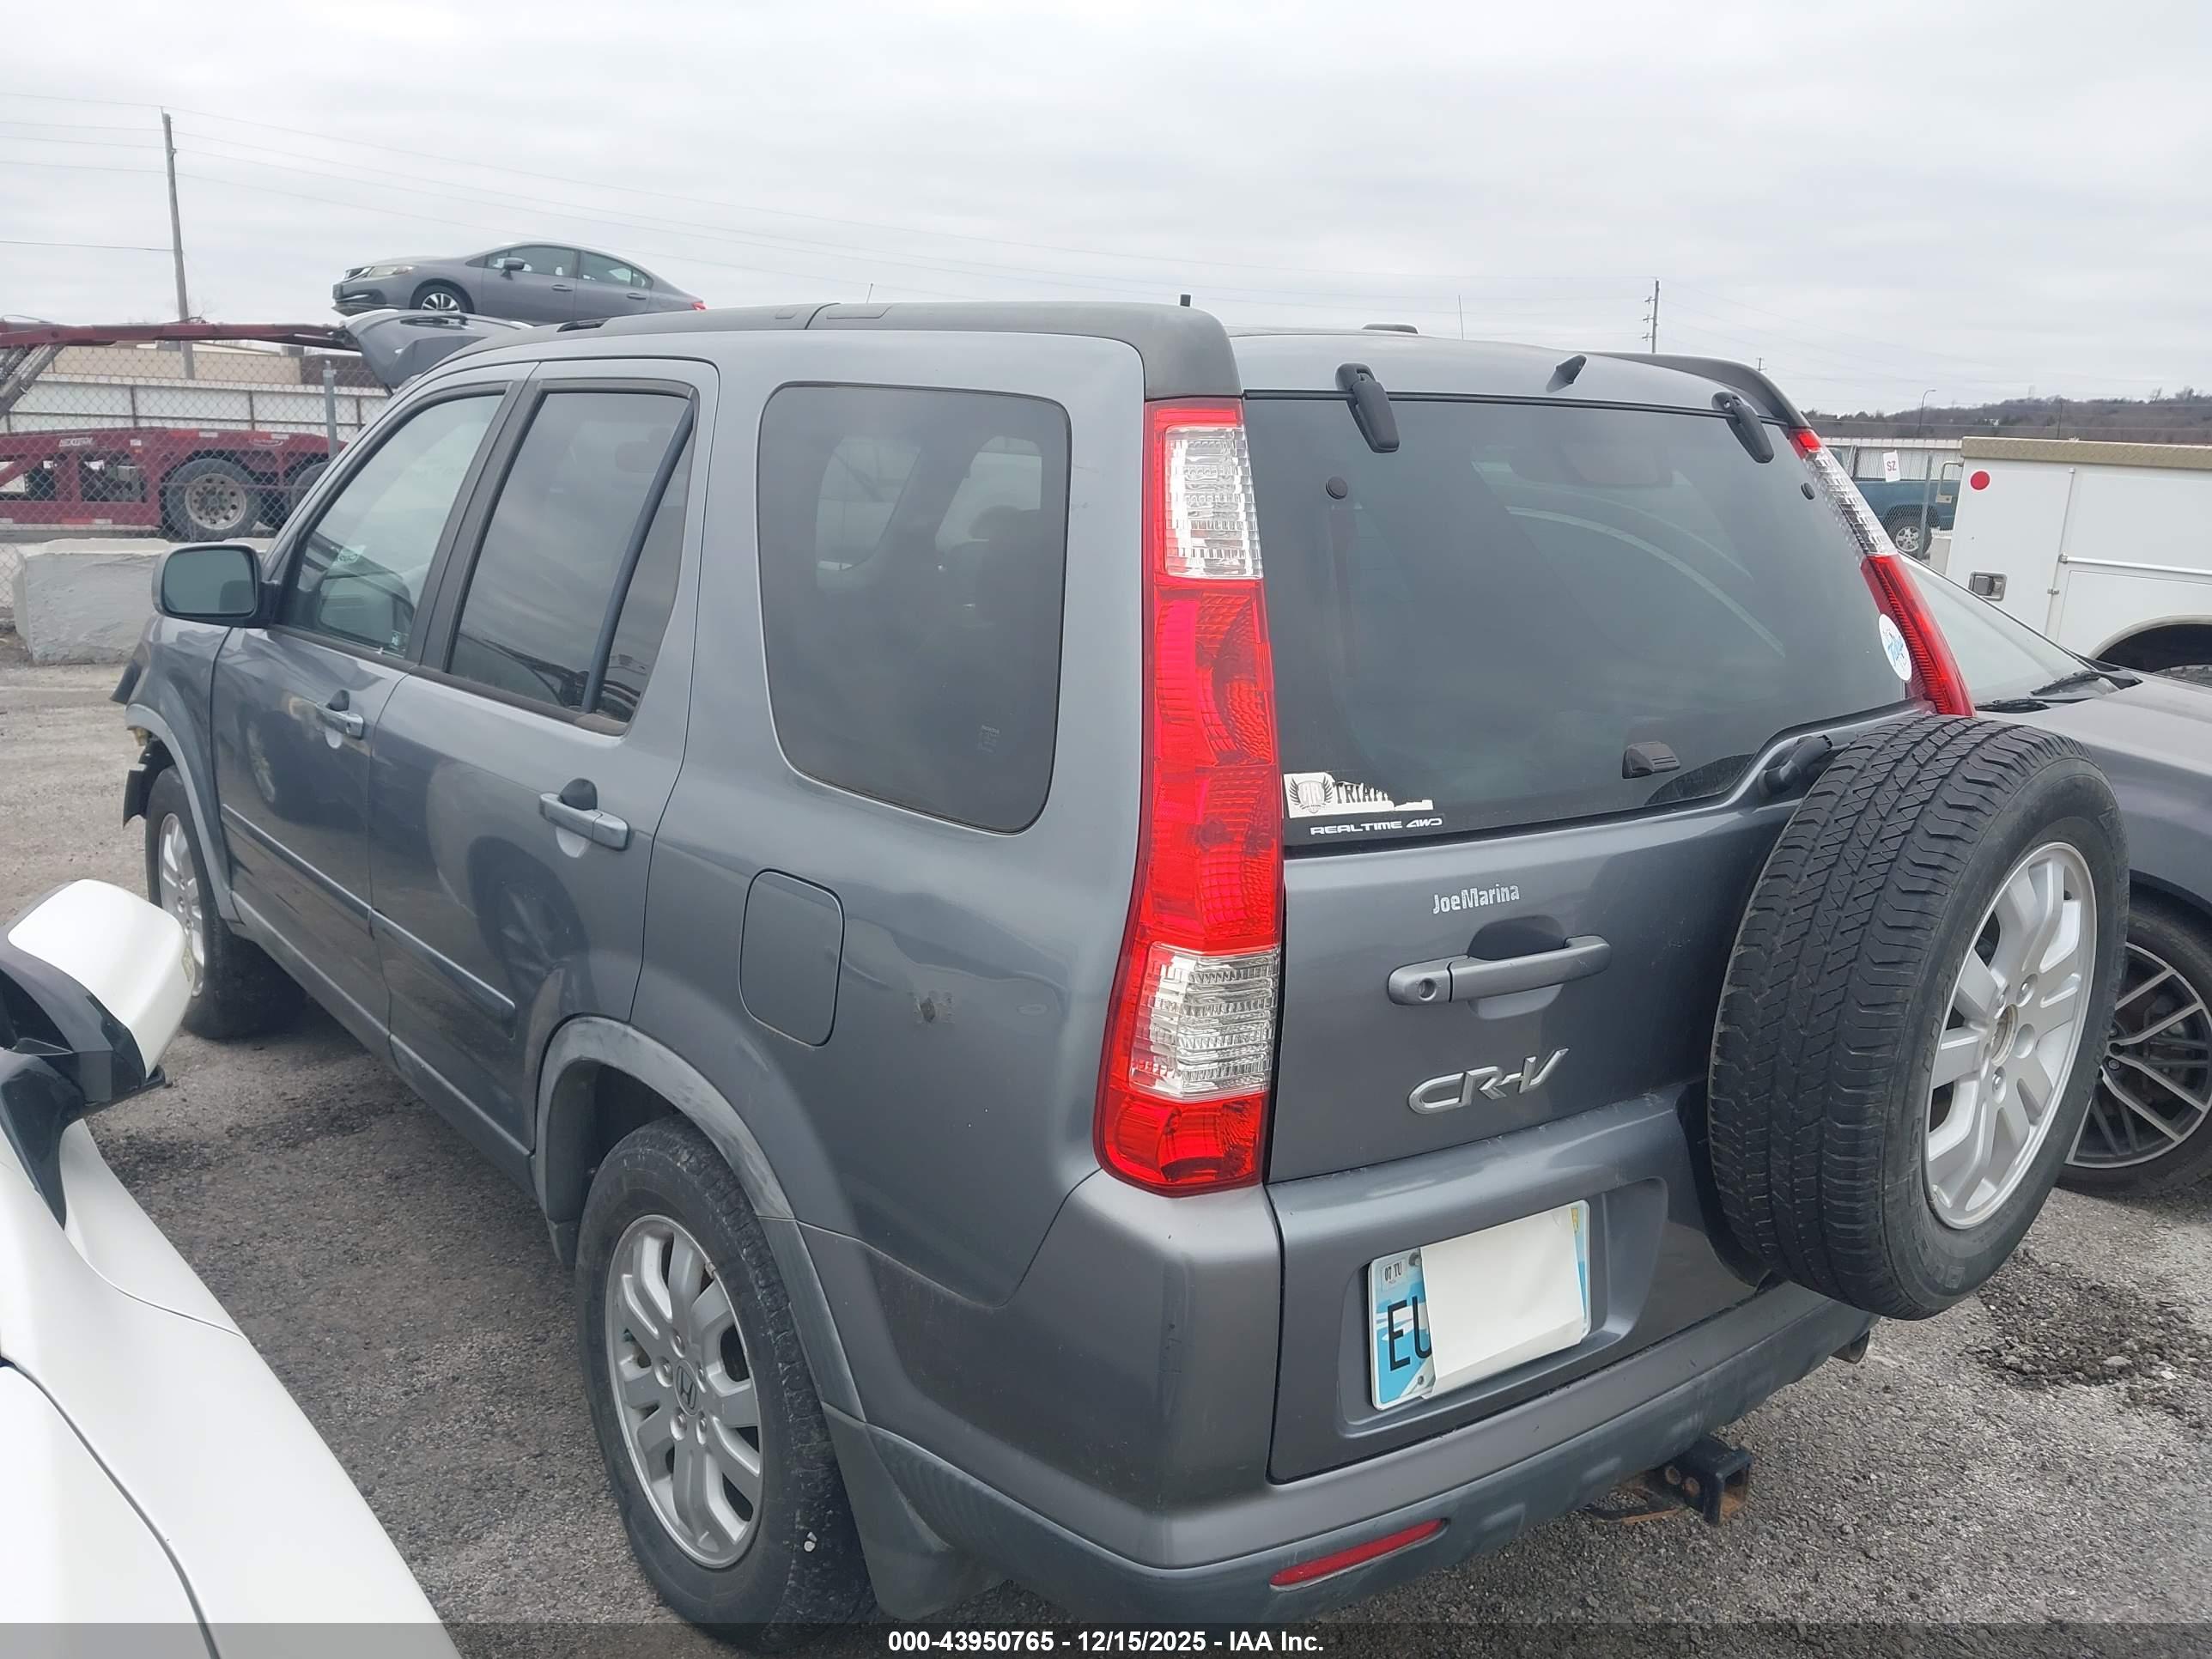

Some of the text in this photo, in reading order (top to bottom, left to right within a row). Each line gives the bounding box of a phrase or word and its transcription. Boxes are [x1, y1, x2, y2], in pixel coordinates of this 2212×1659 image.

[1310, 817, 1443, 836] REALTIME 4WD
[1432, 884, 1521, 915] JoeMarina
[1407, 1048, 1571, 1115] CR-V
